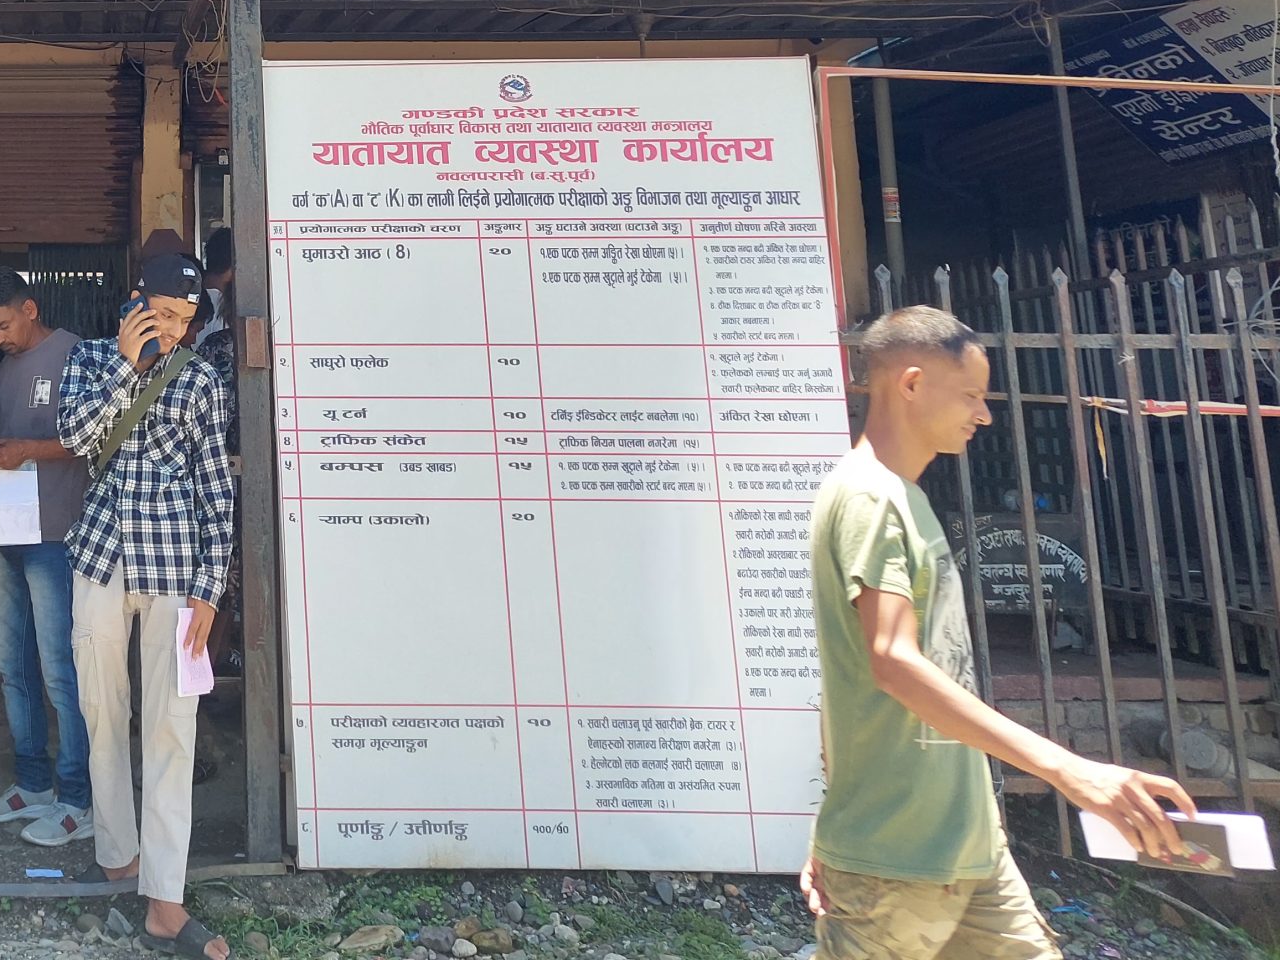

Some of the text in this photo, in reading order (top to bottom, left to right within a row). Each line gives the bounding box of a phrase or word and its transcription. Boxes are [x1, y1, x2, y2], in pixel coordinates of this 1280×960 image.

[401, 105, 640, 120] गण्डकी प्रदेश सरकार
[361, 120, 713, 137] भौतिक पूर्वाधार विकास तथा यातायात व्यवस्था मन्त्रालय
[312, 131, 775, 167] यातायात व्यवस्था कार्यालय
[436, 168, 525, 182] नवलपरासी
[292, 190, 310, 208] वर्ग
[352, 193, 364, 208] वा
[385, 187, 405, 208] (K)
[408, 192, 424, 207] का
[426, 188, 455, 208] लागी
[494, 188, 555, 208] प्रयोगात्मक
[558, 187, 608, 208] परीक्षाको
[636, 187, 681, 206] विभाजन
[685, 190, 708, 206] तथा
[765, 190, 801, 206] आधार
[354, 247, 382, 260] आठ
